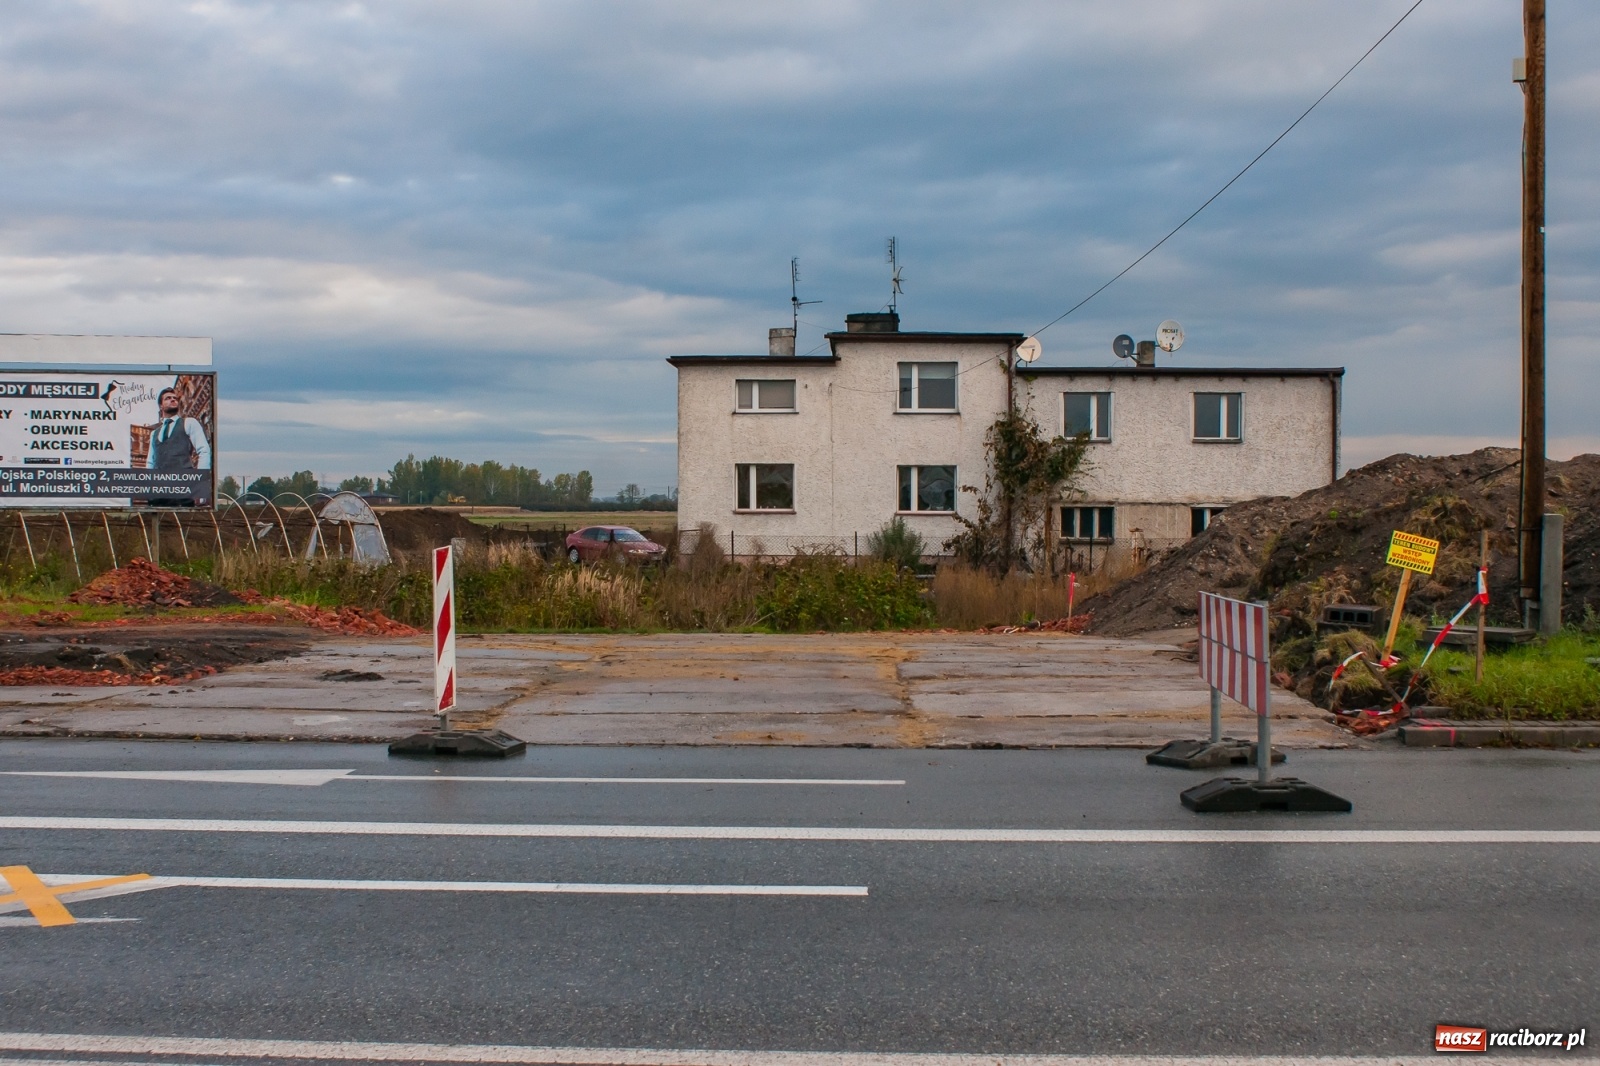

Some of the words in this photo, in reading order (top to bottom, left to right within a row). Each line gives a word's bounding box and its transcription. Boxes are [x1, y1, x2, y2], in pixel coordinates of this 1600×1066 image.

[31, 384, 95, 398] MĘSKIEJ
[30, 410, 117, 421] MARYNARKI
[30, 425, 88, 436] OBUWIE
[30, 440, 114, 451] AKCESORIA
[0, 470, 34, 482] ojska
[37, 470, 97, 483] Polskiego
[99, 470, 110, 482] 2,
[113, 473, 152, 481] PAWILON
[153, 473, 203, 482] HANDLOWY
[2, 482, 17, 493] ul.
[20, 482, 80, 493] Moniuszki
[83, 483, 94, 495] 9,
[111, 486, 151, 494] PRZECIW
[152, 486, 192, 494] RATUSZA
[1394, 540, 1411, 548] TEREN
[1411, 544, 1434, 553] BUDOWY
[1391, 552, 1430, 565] WZBRONIONY
